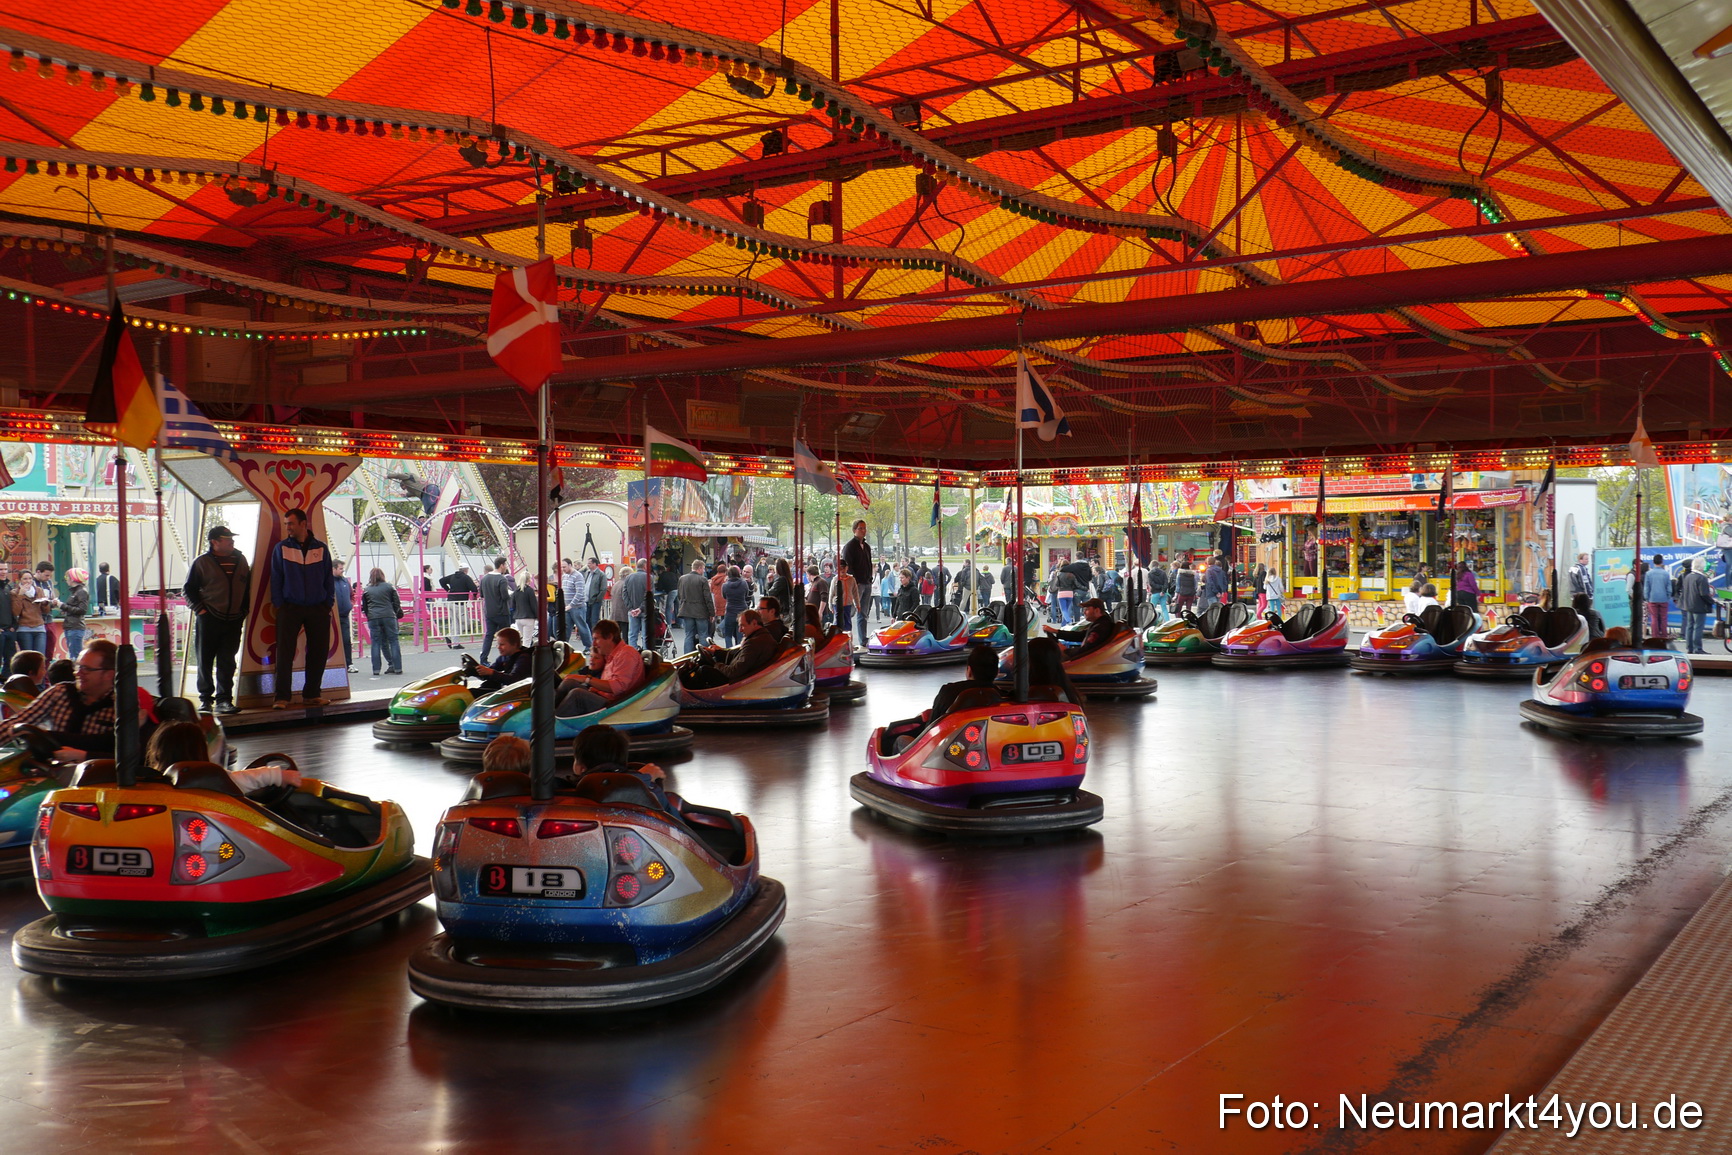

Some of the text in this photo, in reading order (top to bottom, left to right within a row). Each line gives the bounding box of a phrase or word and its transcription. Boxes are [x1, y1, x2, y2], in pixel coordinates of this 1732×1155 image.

[1028, 745, 1055, 756] 06
[100, 852, 141, 866] 09
[525, 872, 563, 887] 18
